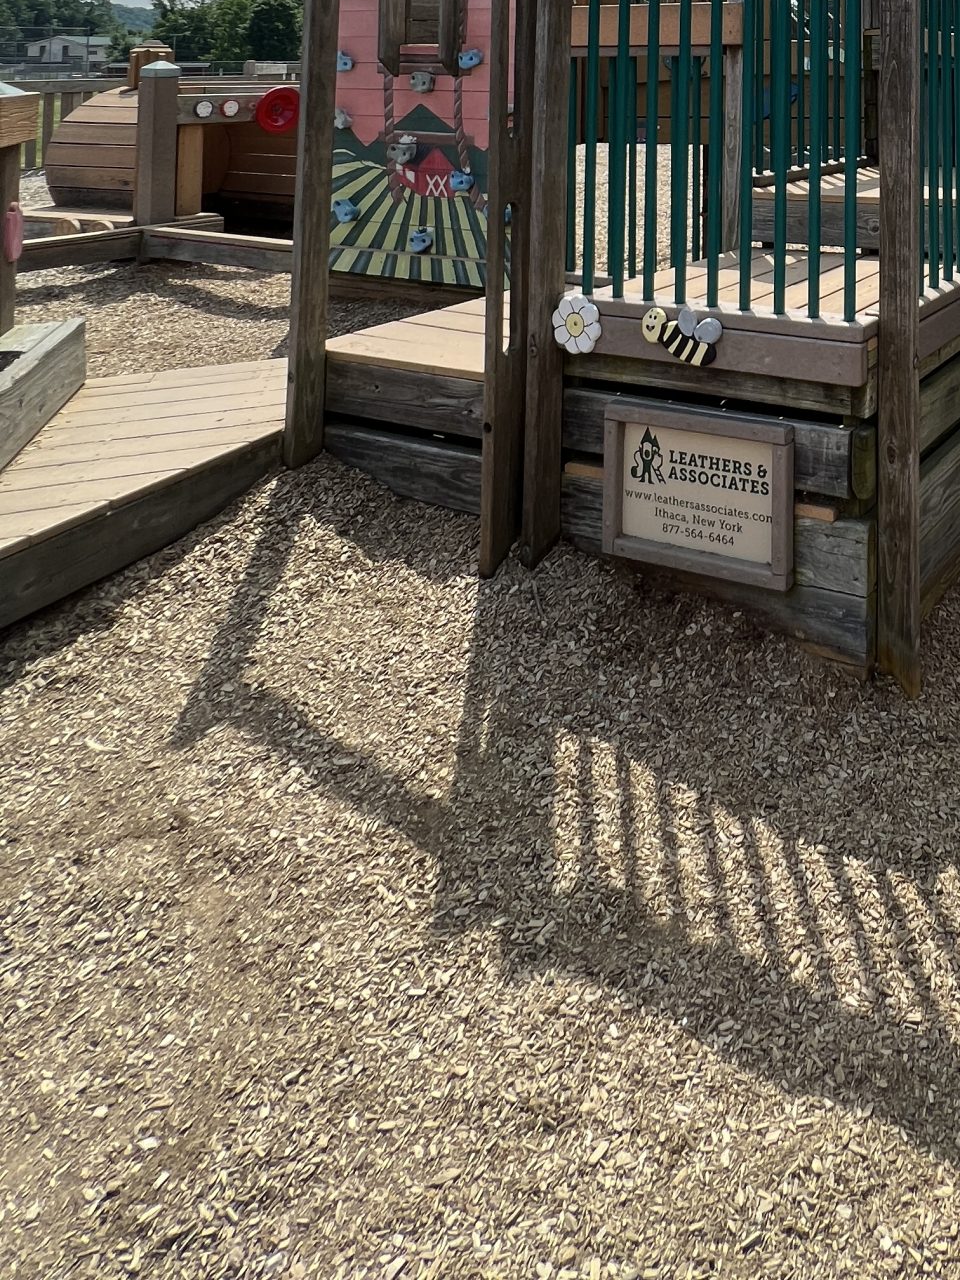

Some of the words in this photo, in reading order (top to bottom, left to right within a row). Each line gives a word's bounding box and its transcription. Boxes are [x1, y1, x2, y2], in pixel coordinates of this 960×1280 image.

[668, 450, 752, 477] LEATHERS
[757, 464, 768, 479] &
[668, 466, 770, 496] ASSOCIATES
[654, 507, 689, 524] Ithaca,
[692, 514, 716, 528] New
[719, 519, 743, 533] York
[662, 523, 735, 546] 877-564-6464
